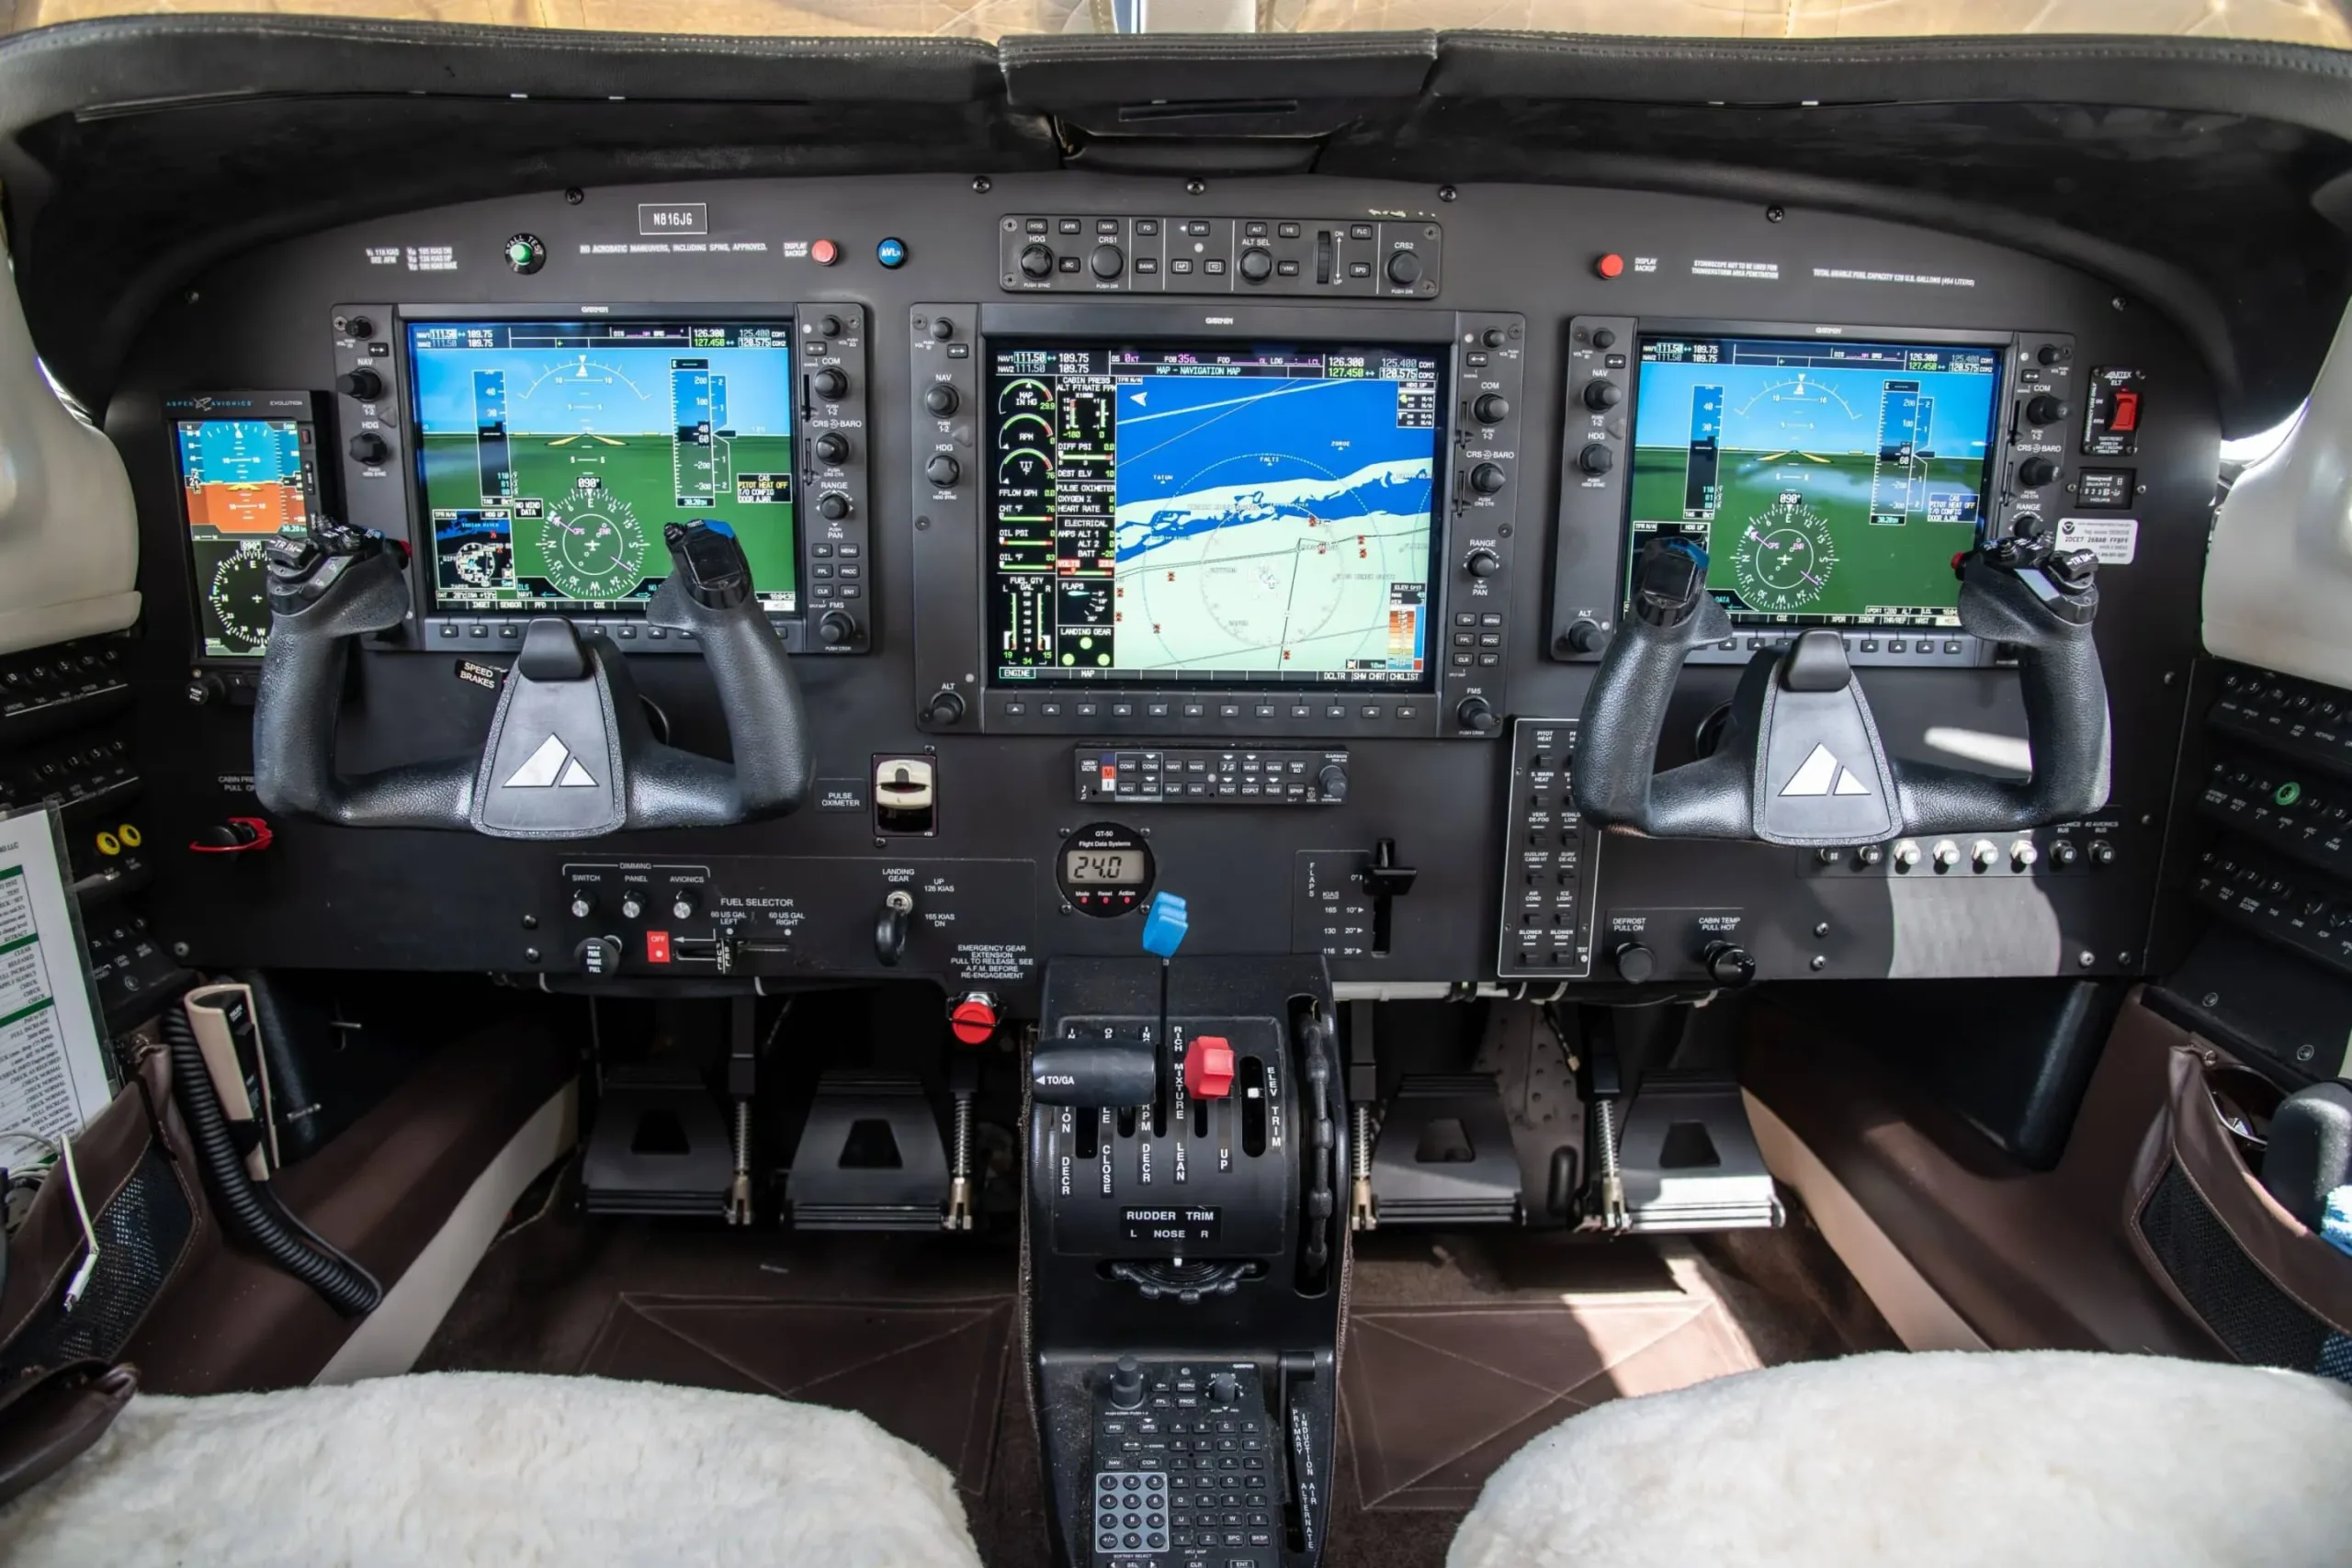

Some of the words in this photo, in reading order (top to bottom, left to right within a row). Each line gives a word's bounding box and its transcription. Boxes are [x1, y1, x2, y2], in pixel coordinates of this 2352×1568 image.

[653, 213, 693, 226] N816JG
[527, 235, 544, 255] TEST
[673, 243, 706, 252] INCLUDING
[1058, 354, 1089, 362] 109.75
[275, 539, 298, 552] TRIM
[460, 671, 495, 689] BRAKES
[464, 662, 493, 678] SPEED
[1074, 856, 1122, 878] 24.0
[746, 898, 794, 907] SELECTOR
[1174, 1027, 1182, 1052] RICH
[1046, 1076, 1074, 1085] TO/GA
[1268, 1067, 1277, 1096] ELEV
[1174, 1064, 1183, 1119] MIXTURE
[1272, 1107, 1281, 1146] TRIM
[1142, 1145, 1151, 1182] DECR
[1221, 1149, 1227, 1169] UP
[1062, 1157, 1070, 1194] DECR
[1126, 1212, 1176, 1221] RUDDER
[1185, 1212, 1214, 1221] TRIM
[1130, 1229, 1136, 1237] L
[1153, 1230, 1185, 1238] NOSE
[1201, 1230, 1208, 1238] R
[1293, 1409, 1303, 1455] PRIMARY
[1302, 1414, 1313, 1475] INDUCTION
[1309, 1483, 1317, 1505] AIR
[1301, 1483, 1314, 1549] ALTERNATE
